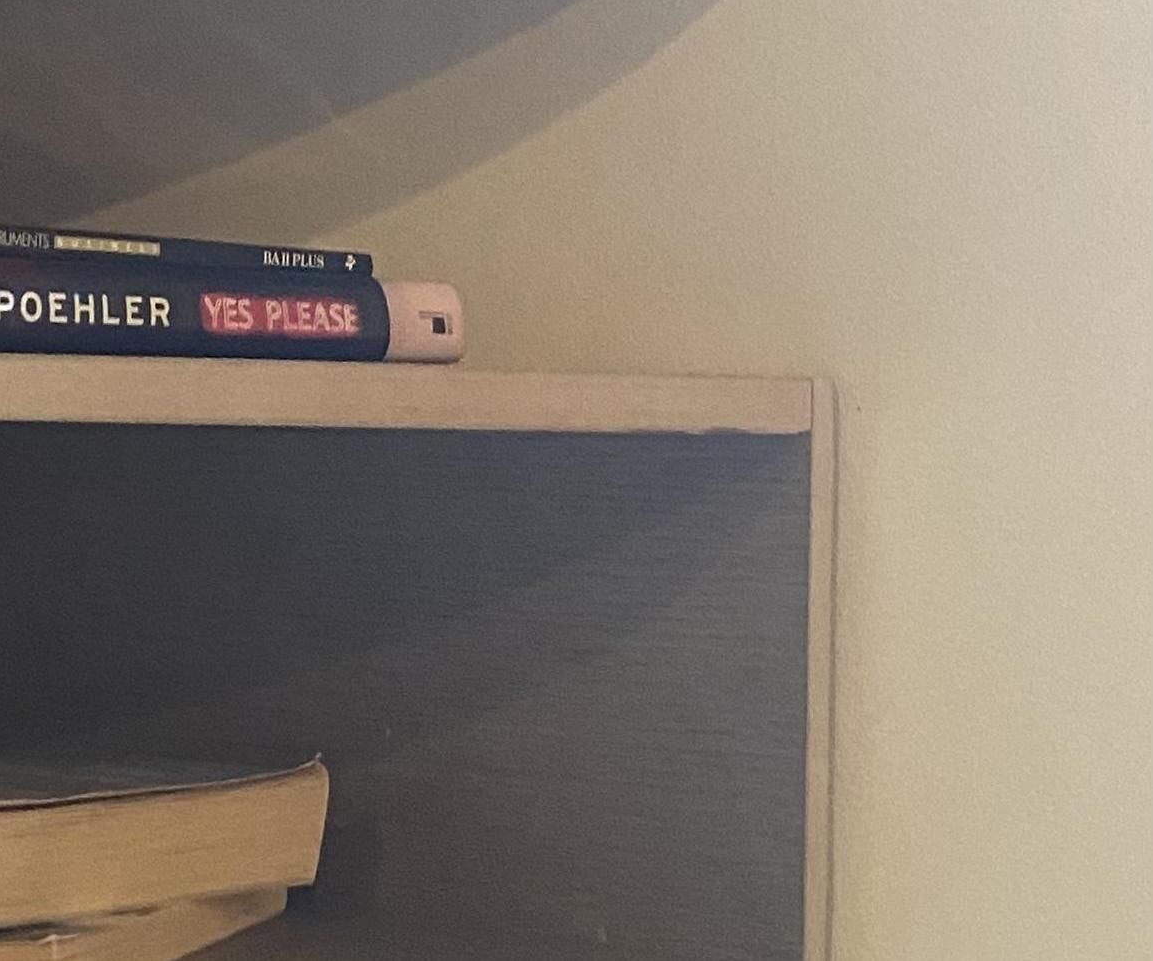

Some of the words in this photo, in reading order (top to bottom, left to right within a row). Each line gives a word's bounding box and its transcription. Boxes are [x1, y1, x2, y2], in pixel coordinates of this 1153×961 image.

[292, 251, 325, 269] PLUS
[203, 295, 252, 331] YES
[265, 299, 360, 333] PLEASE
